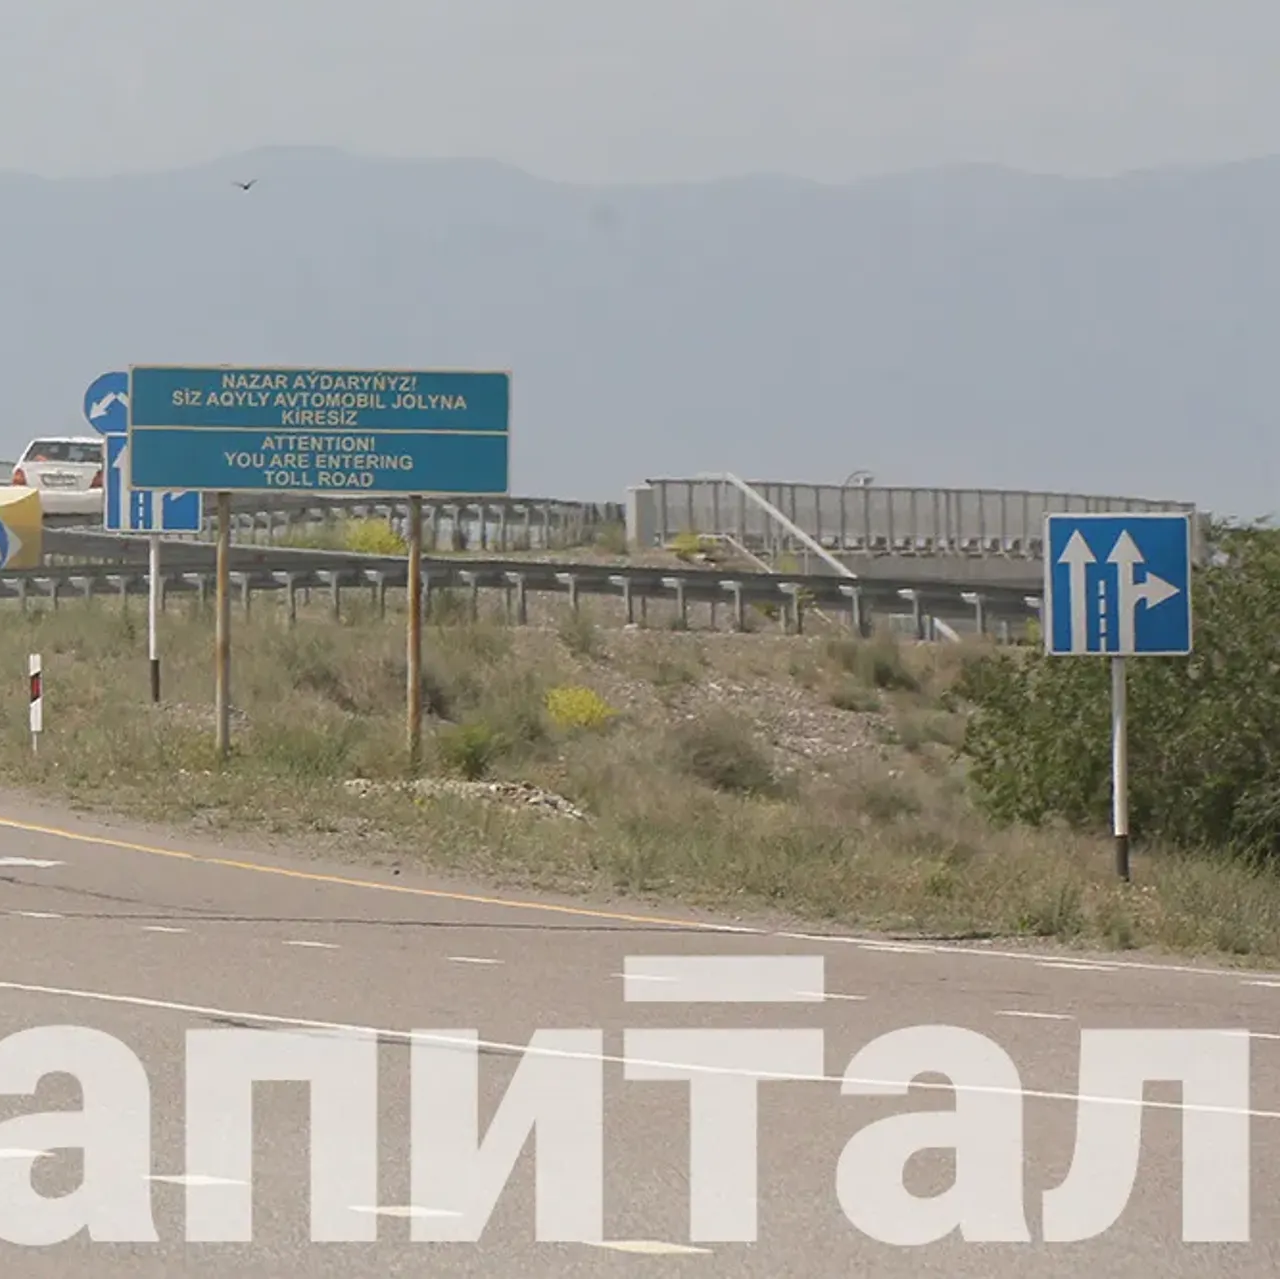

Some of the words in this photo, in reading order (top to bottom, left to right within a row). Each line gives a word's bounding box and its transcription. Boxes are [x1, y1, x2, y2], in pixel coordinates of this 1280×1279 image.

[221, 373, 288, 390] NAZAR
[391, 393, 468, 411] JOLYNA
[261, 435, 376, 452] ATTENTION!
[224, 451, 264, 468] YOU
[269, 452, 309, 469] ARE
[315, 453, 414, 470] ENTERING
[263, 470, 313, 487] TOLL
[317, 471, 374, 488] ROAD
